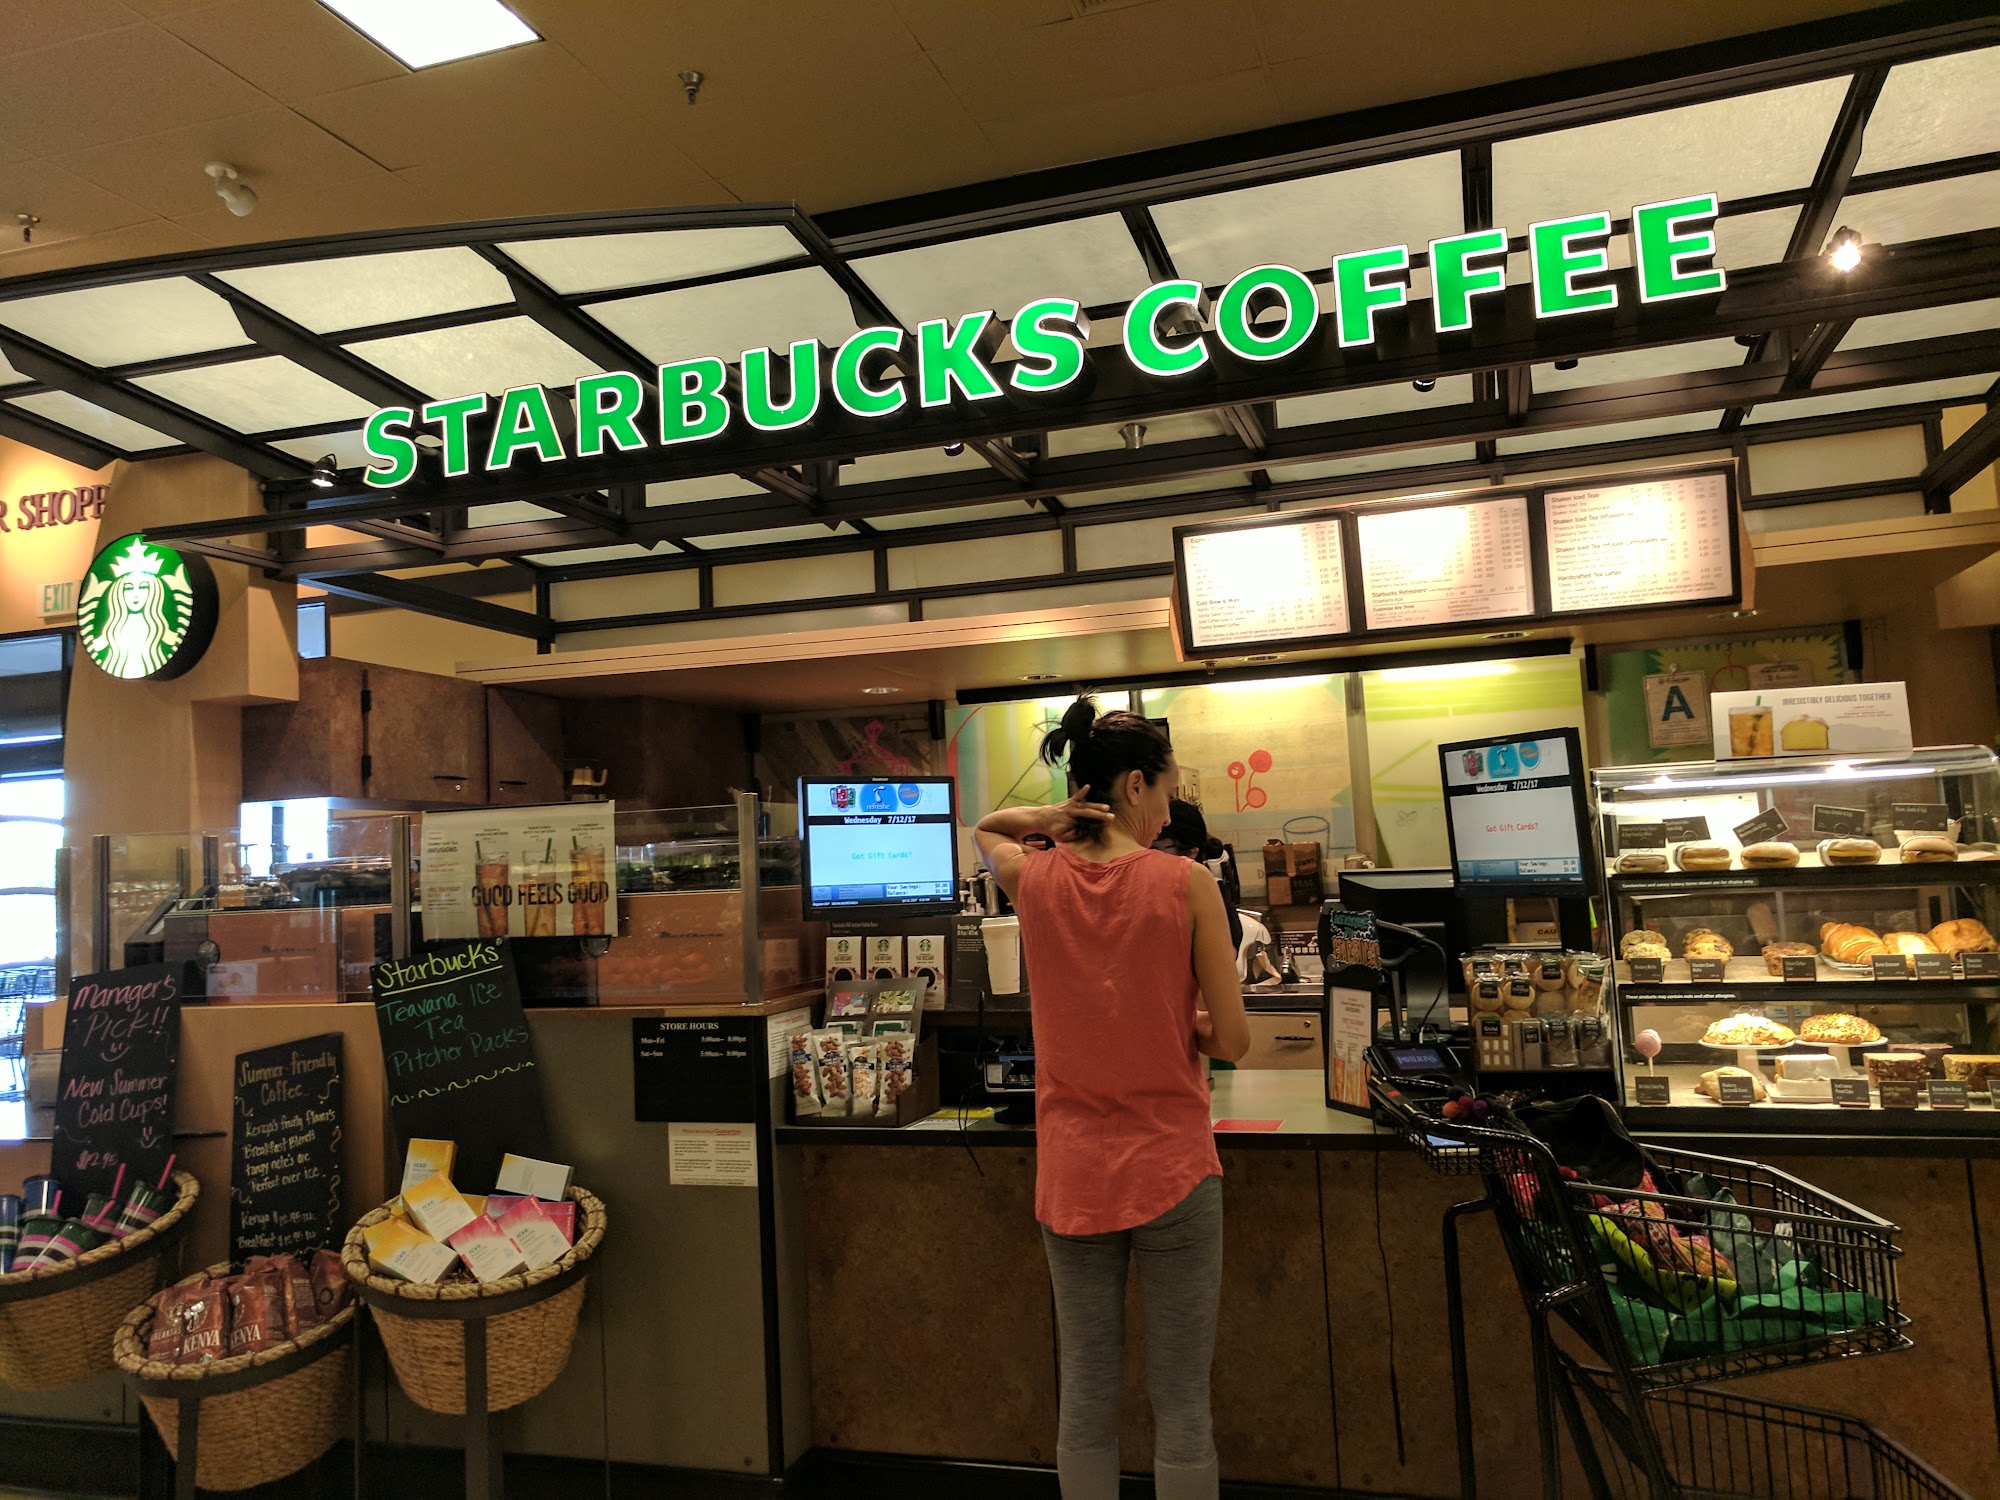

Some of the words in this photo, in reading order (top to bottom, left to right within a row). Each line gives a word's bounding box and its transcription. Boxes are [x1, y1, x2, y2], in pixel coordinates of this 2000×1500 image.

[362, 298, 1088, 489] STARBUCKS
[1122, 192, 1727, 377] COFFEE
[43, 581, 74, 613] EXIT
[1661, 685, 1695, 722] A
[1825, 694, 1857, 703] DELICIOUS
[1476, 783, 1508, 793] Wednesday
[1512, 780, 1538, 790] 7/12/17
[472, 884, 513, 907] GOOD
[518, 882, 563, 905] FEELS
[567, 881, 609, 904] GOOD
[415, 1014, 467, 1040] Tea
[388, 1045, 462, 1076] Pitcher
[63, 1076, 104, 1100] New
[110, 1069, 168, 1096] Summer
[78, 1101, 115, 1128] Cold
[120, 1094, 168, 1122] Cups!
[282, 1172, 301, 1185] over
[183, 1330, 220, 1355] KENYA
[231, 1324, 261, 1347] KENYA
